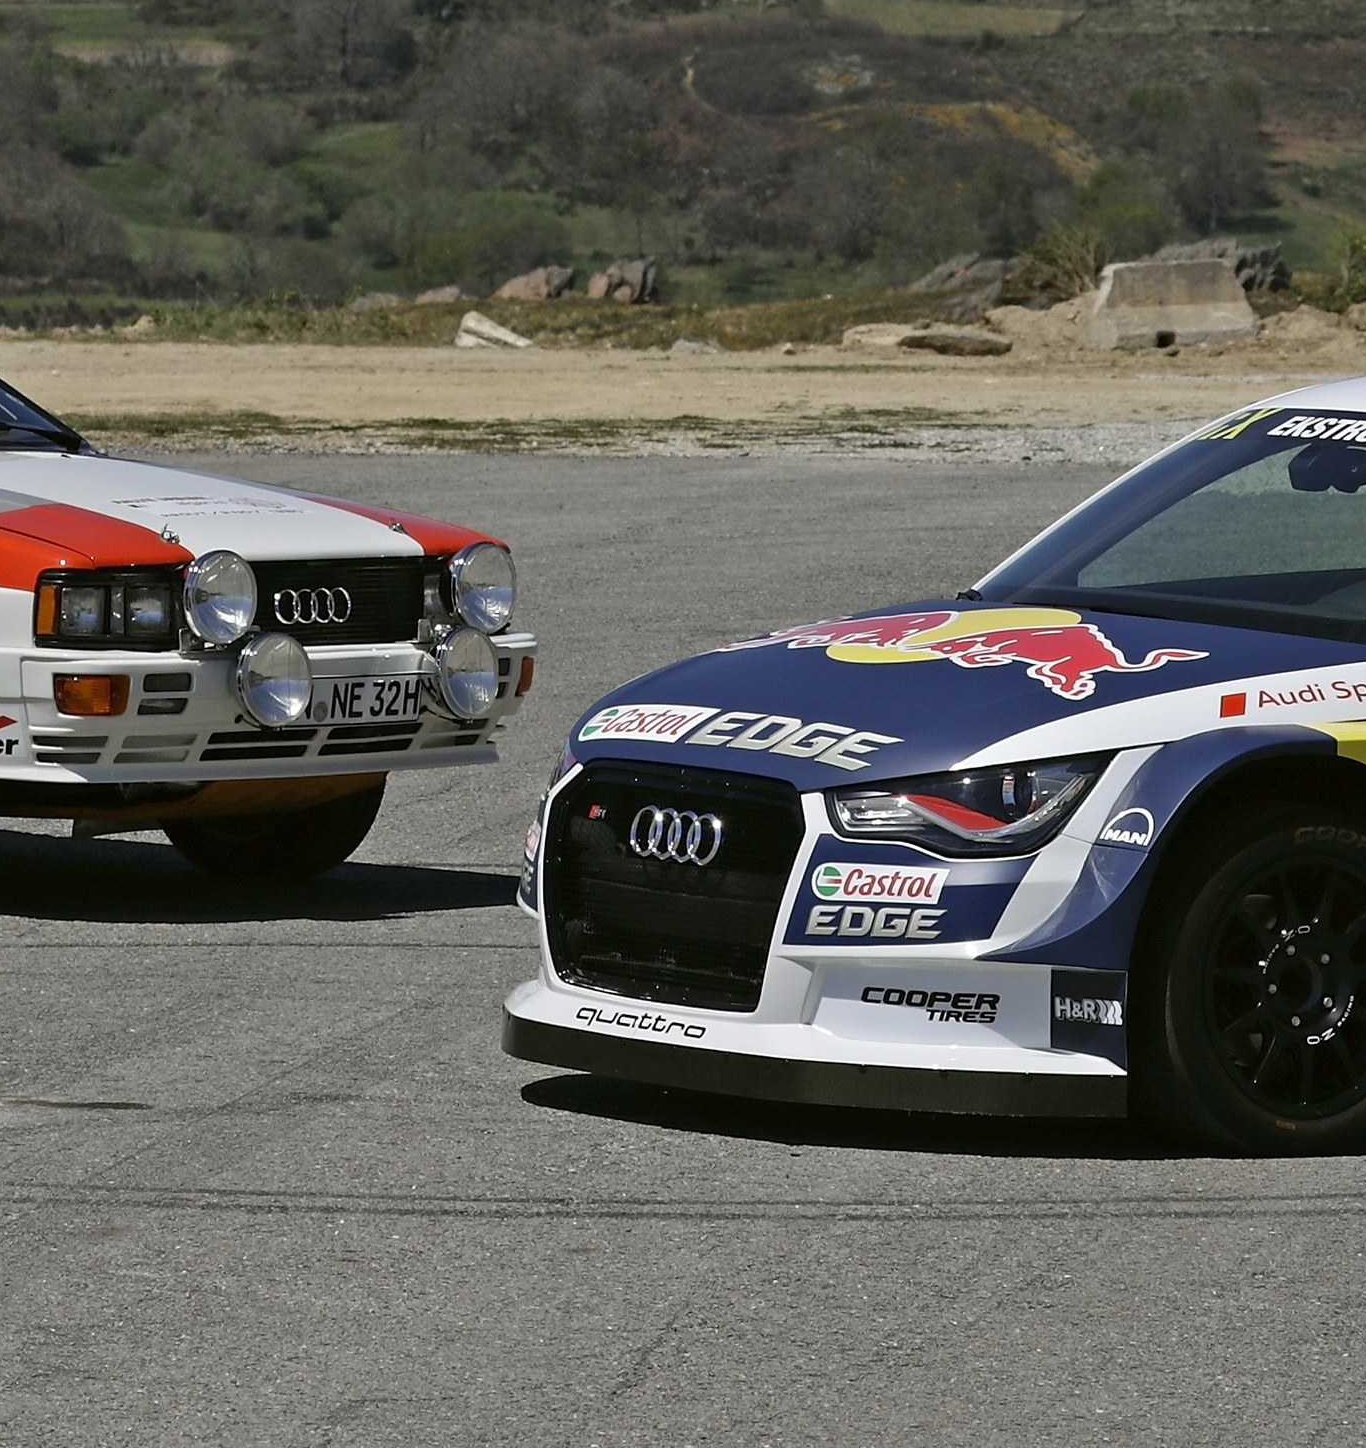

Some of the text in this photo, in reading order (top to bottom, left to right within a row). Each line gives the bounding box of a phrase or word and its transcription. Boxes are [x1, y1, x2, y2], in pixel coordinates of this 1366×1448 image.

[330, 682, 365, 719] NE
[1258, 684, 1325, 708] Audi
[603, 707, 905, 772] Castrol EDGE
[1103, 828, 1148, 846] MAN
[843, 868, 938, 898] Castrol
[804, 904, 949, 939] EDGE
[861, 986, 1000, 1011] COOPER
[576, 1007, 706, 1039] quattro
[925, 1009, 997, 1024] TIRES
